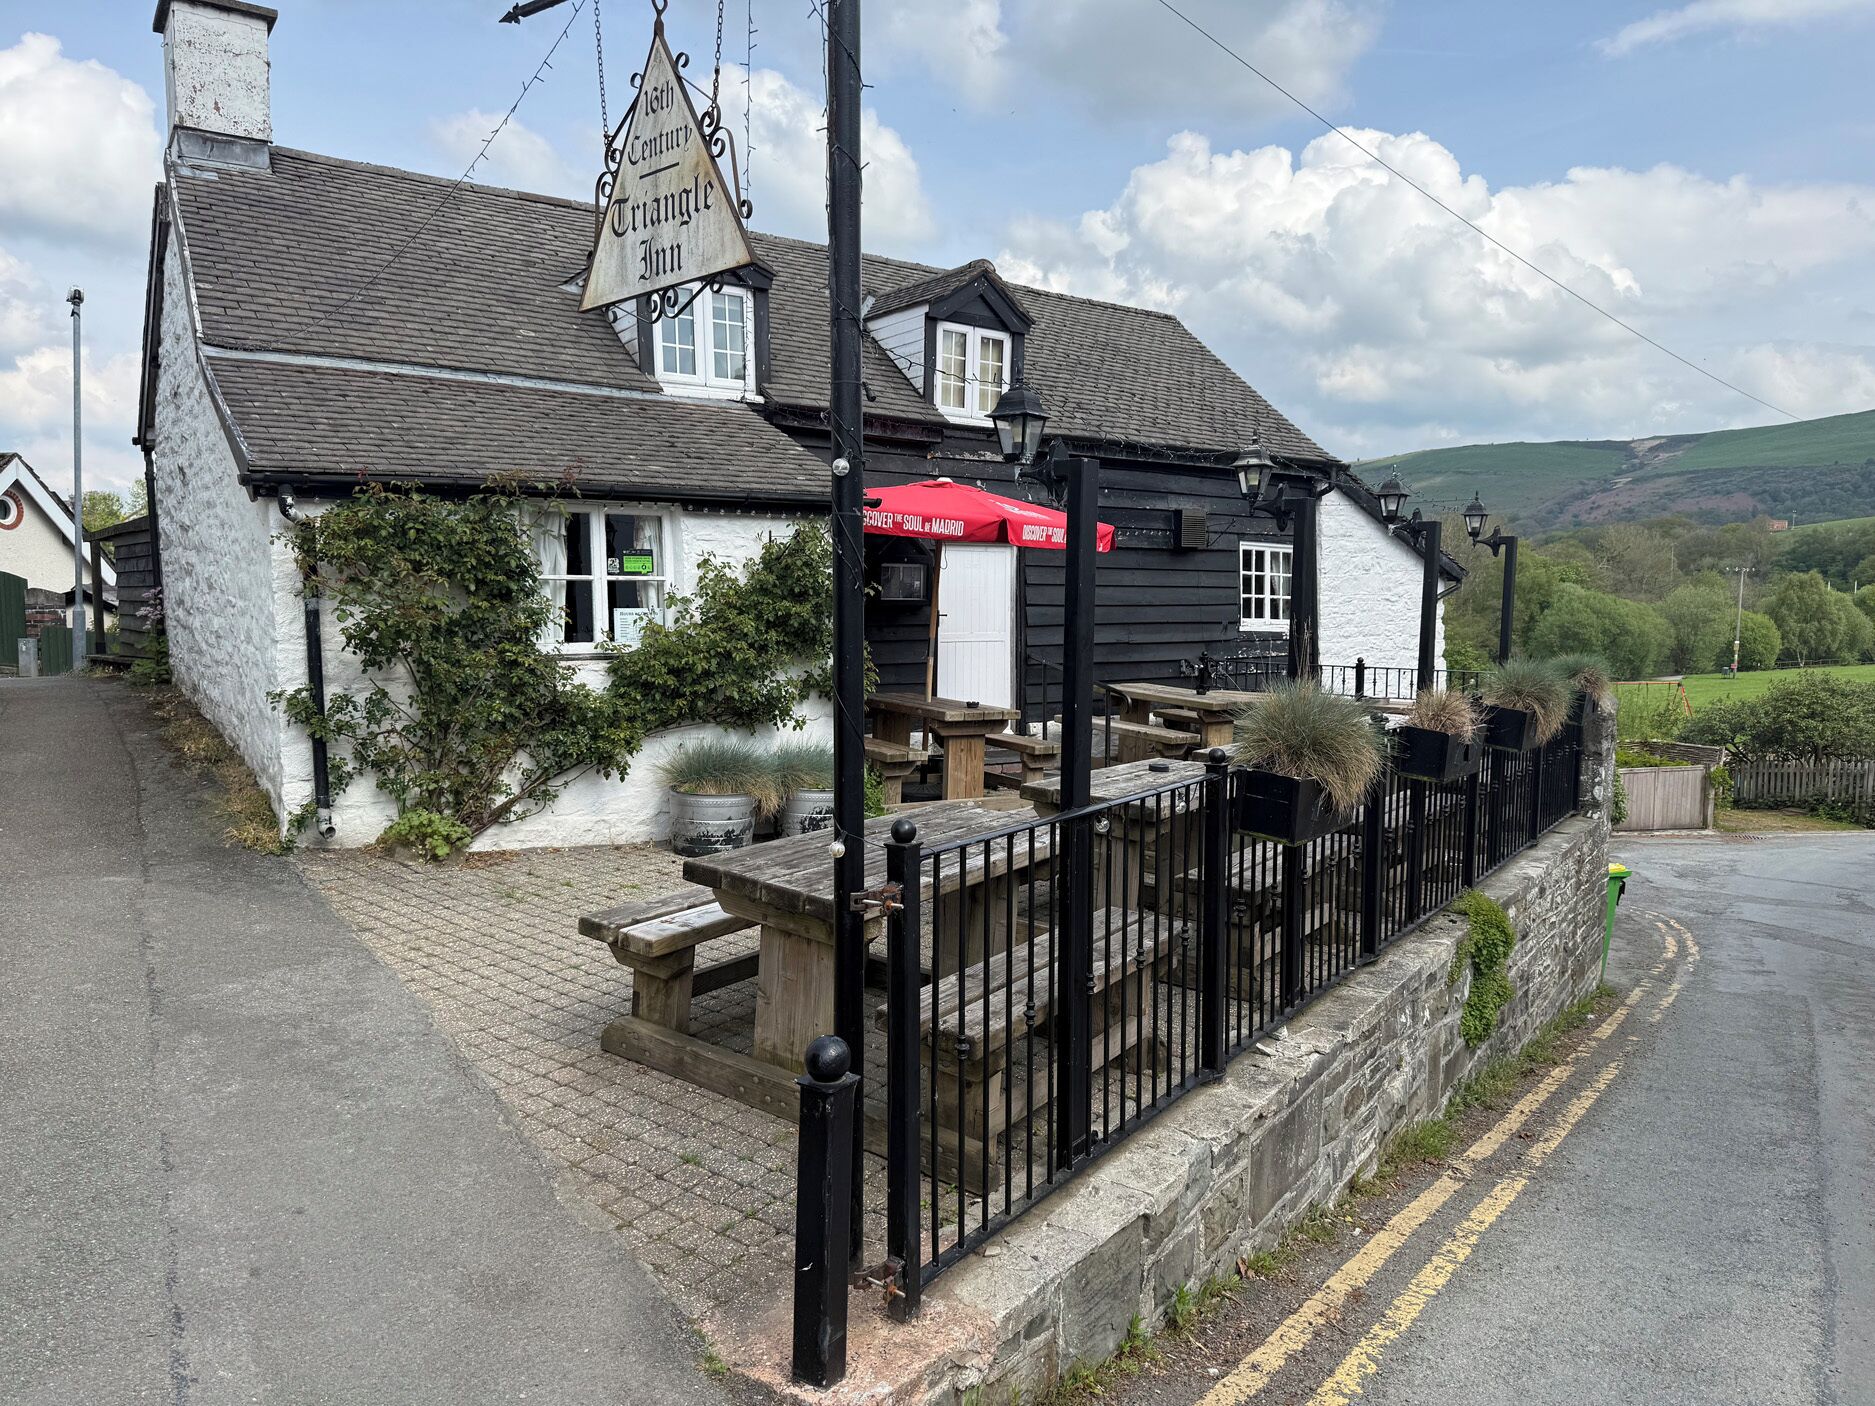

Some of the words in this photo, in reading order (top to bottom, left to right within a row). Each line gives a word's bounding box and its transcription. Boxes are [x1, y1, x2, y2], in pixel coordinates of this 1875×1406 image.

[644, 80, 675, 117] 16th
[627, 124, 693, 166] Century
[611, 175, 715, 238] Triangle
[638, 237, 683, 284] Inn
[894, 513, 903, 523] THE
[903, 514, 924, 532] SOUL
[931, 517, 964, 537] MADRID
[1022, 524, 1048, 542] DISCOVER
[1052, 527, 1065, 543] SOUL
